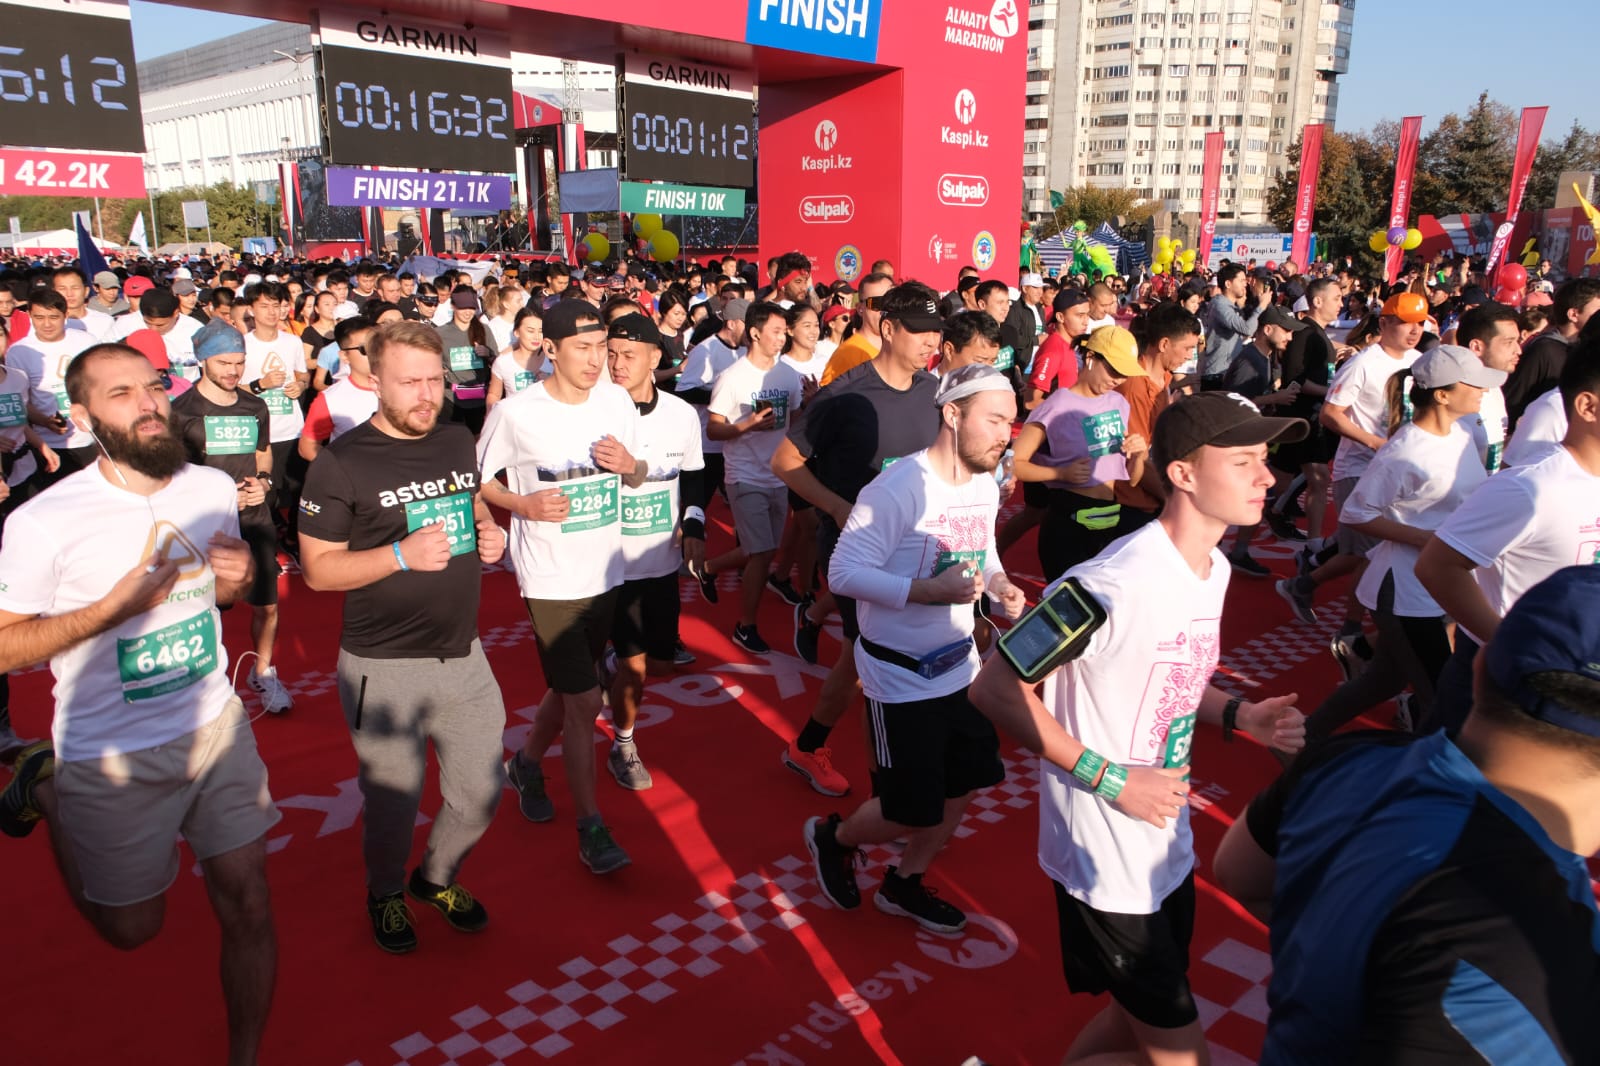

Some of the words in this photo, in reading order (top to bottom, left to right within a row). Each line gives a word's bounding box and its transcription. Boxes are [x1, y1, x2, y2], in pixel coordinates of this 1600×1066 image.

[759, 0, 870, 38] FINISH
[945, 6, 989, 31] ALMATY
[356, 21, 478, 57] GARMIN
[944, 27, 1005, 54] MARATHON
[648, 61, 730, 91] GARMIN
[335, 81, 508, 140] 00:16:32
[632, 112, 749, 160] 00:01:12
[941, 126, 989, 149] Kaspi.kz
[14, 159, 110, 189] 42.2K
[802, 154, 852, 173] Kaspi.kz
[353, 176, 429, 201] FINISH
[433, 180, 491, 204] 21.1K
[645, 189, 696, 211] FINISH
[701, 192, 726, 211] 10K
[942, 179, 986, 202] Sulpak
[803, 200, 850, 220] Sulpak
[1250, 247, 1277, 256] Kaspi.kz
[214, 426, 251, 439] 5822
[1093, 421, 1121, 439] 8267
[378, 471, 476, 508] aster.kz
[571, 492, 612, 513] 9284
[624, 503, 662, 520] 9287
[137, 635, 205, 673] 6462
[731, 961, 934, 1066] Kaspi.k
